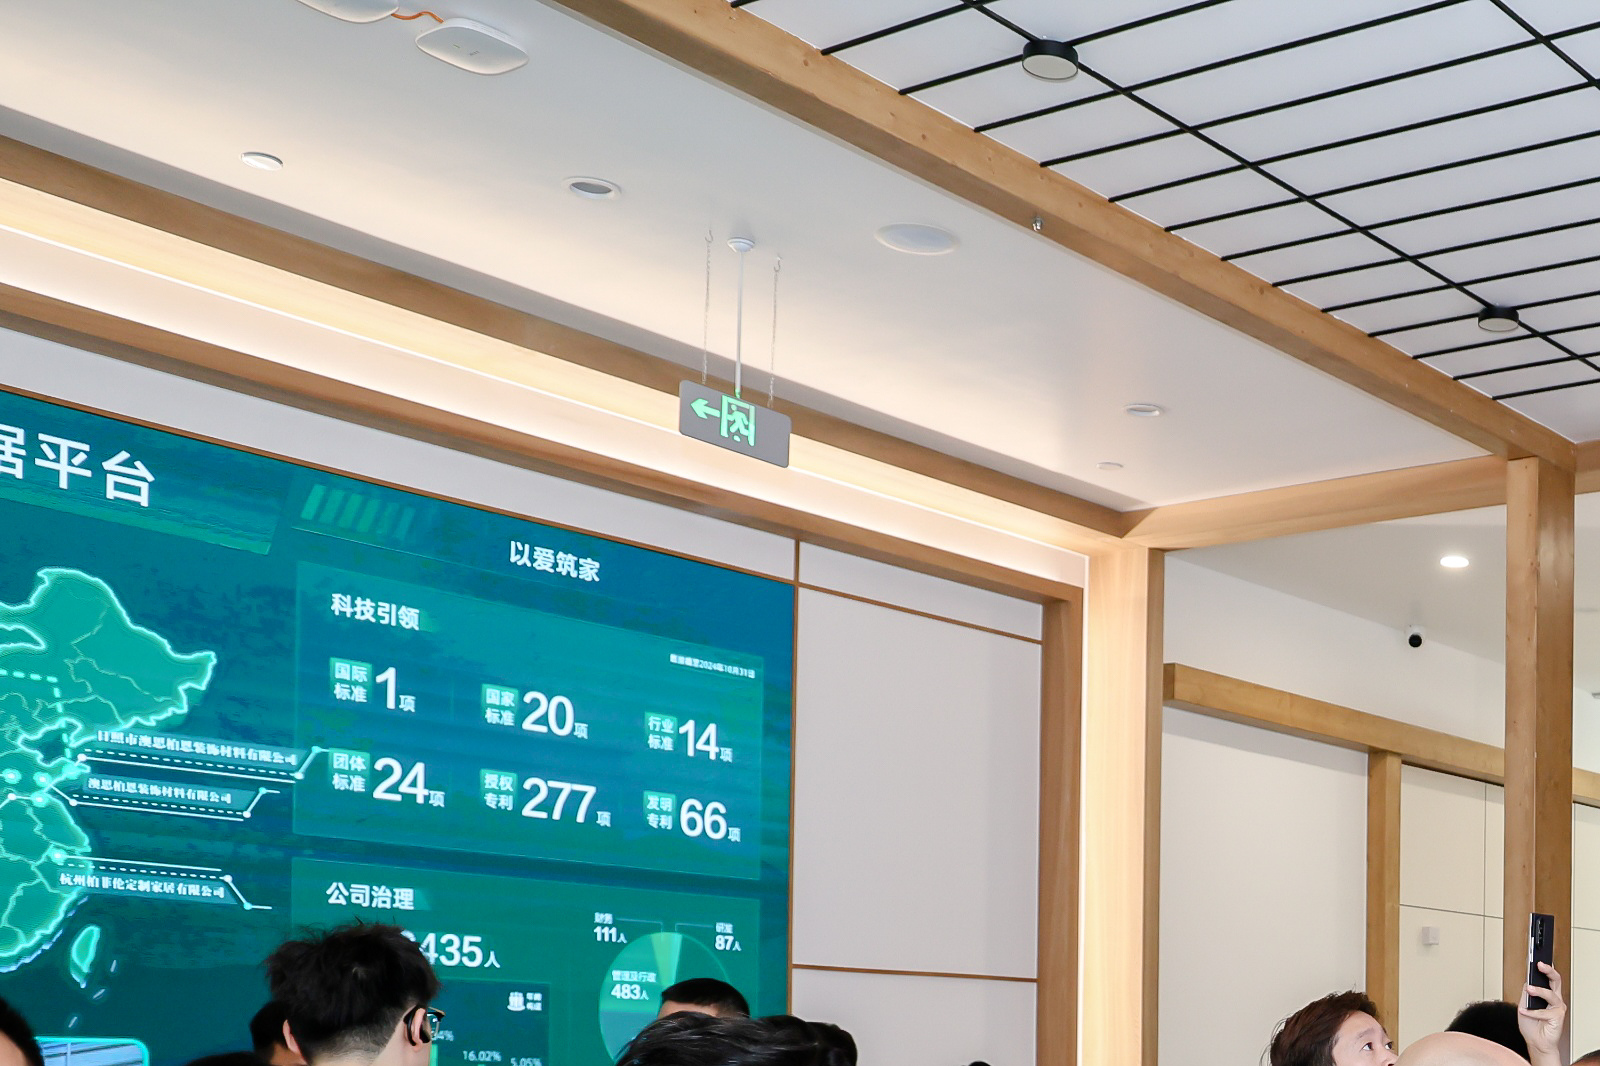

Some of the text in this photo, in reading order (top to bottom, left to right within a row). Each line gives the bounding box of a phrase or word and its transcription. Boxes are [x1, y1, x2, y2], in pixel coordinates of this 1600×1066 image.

[509, 540, 601, 582] 以爱筑家
[331, 593, 420, 631] 科技引领
[335, 662, 368, 682] 国际
[334, 682, 368, 703] 标准
[485, 687, 516, 707] 国家
[484, 707, 516, 727] 标准
[648, 715, 675, 735] 行业
[647, 733, 675, 752] 标准
[333, 752, 367, 771] 团体
[332, 773, 366, 792] 标准
[484, 772, 515, 792] 授权
[484, 791, 514, 812] 专利
[646, 795, 674, 814] 发明
[646, 812, 674, 831] 专利
[326, 882, 414, 910] 公司治理
[714, 935, 742, 952] 87人
[610, 983, 650, 1001] 483人
[462, 1050, 502, 1062] 16.02%
